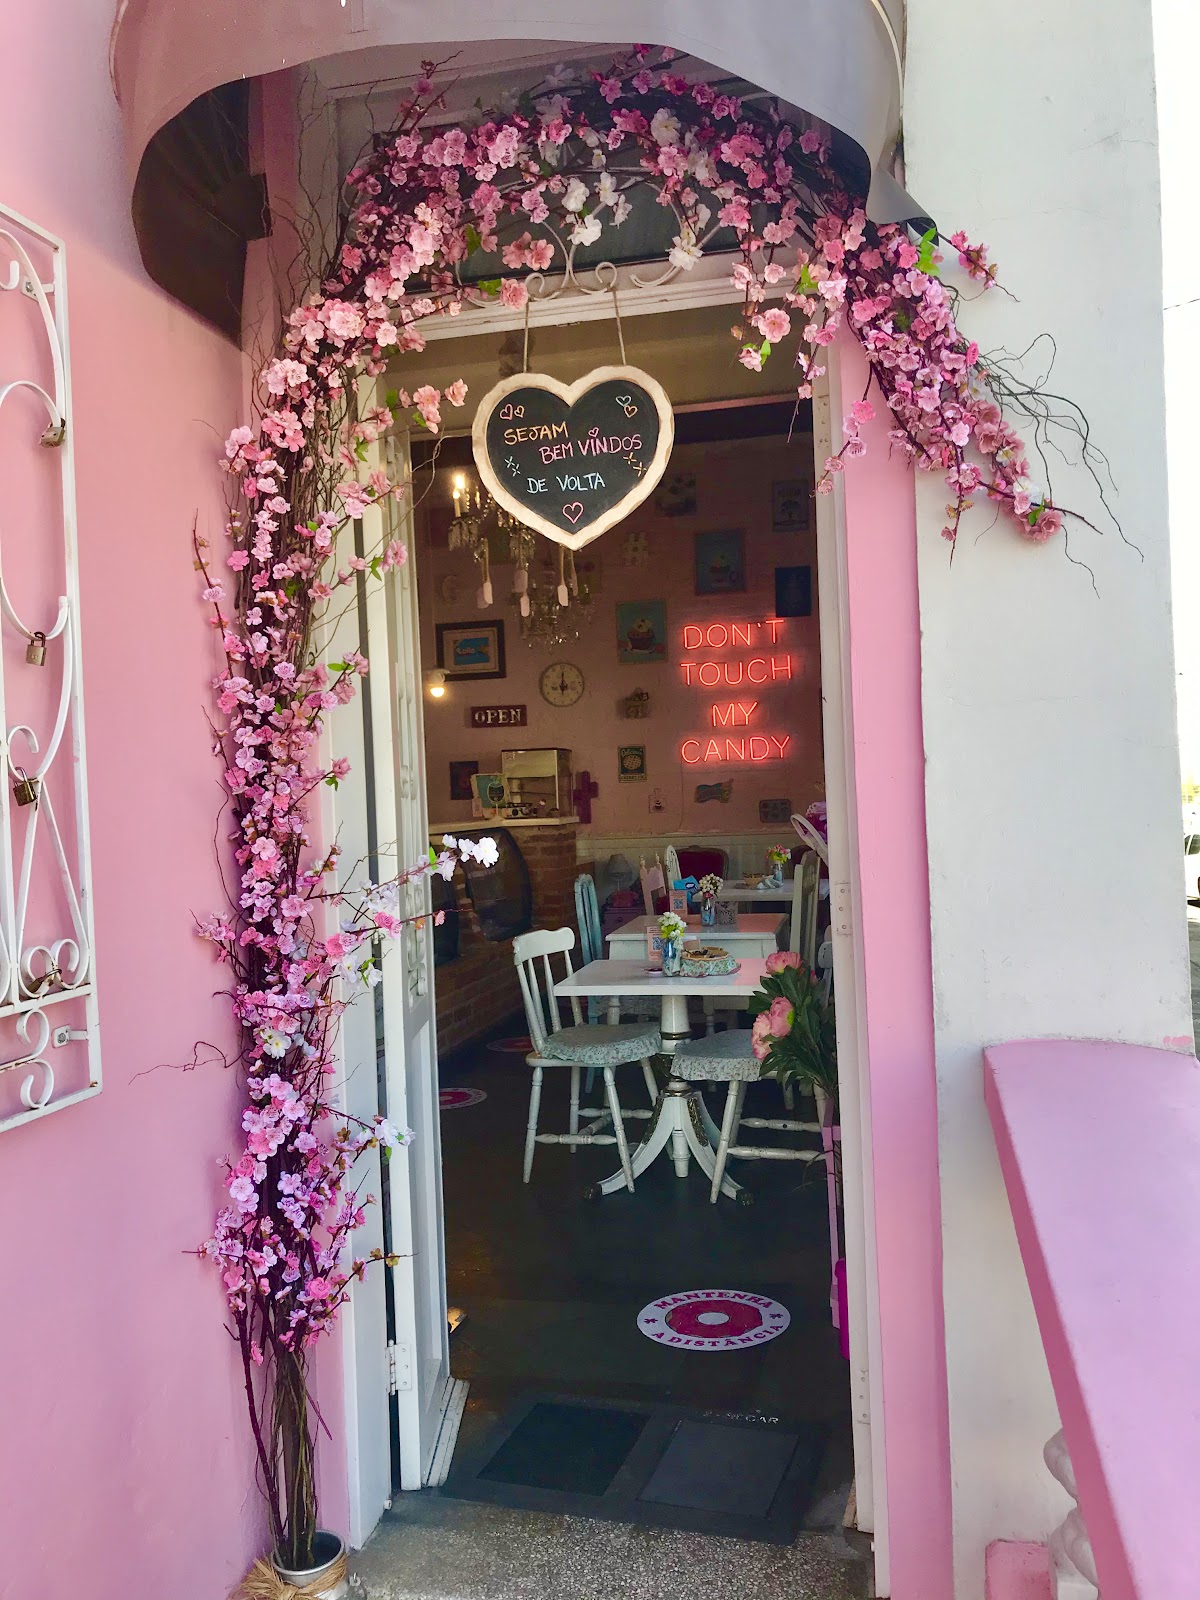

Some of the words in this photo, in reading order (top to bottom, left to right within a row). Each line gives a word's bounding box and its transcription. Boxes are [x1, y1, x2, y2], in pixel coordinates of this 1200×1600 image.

[504, 421, 569, 446] SEJAM
[539, 443, 574, 465] BEM
[577, 433, 643, 457] VINDOS
[526, 477, 548, 494] DE
[556, 472, 606, 492] VOLTA
[683, 619, 785, 650] DON'T
[680, 655, 792, 686] TOUCH
[474, 708, 522, 724] OPEN
[711, 701, 758, 727] MY
[681, 735, 790, 764] CANDY
[653, 1291, 774, 1310] MANTENHA
[652, 1332, 665, 1340] A
[667, 1324, 785, 1347] DISTÂNCIA
